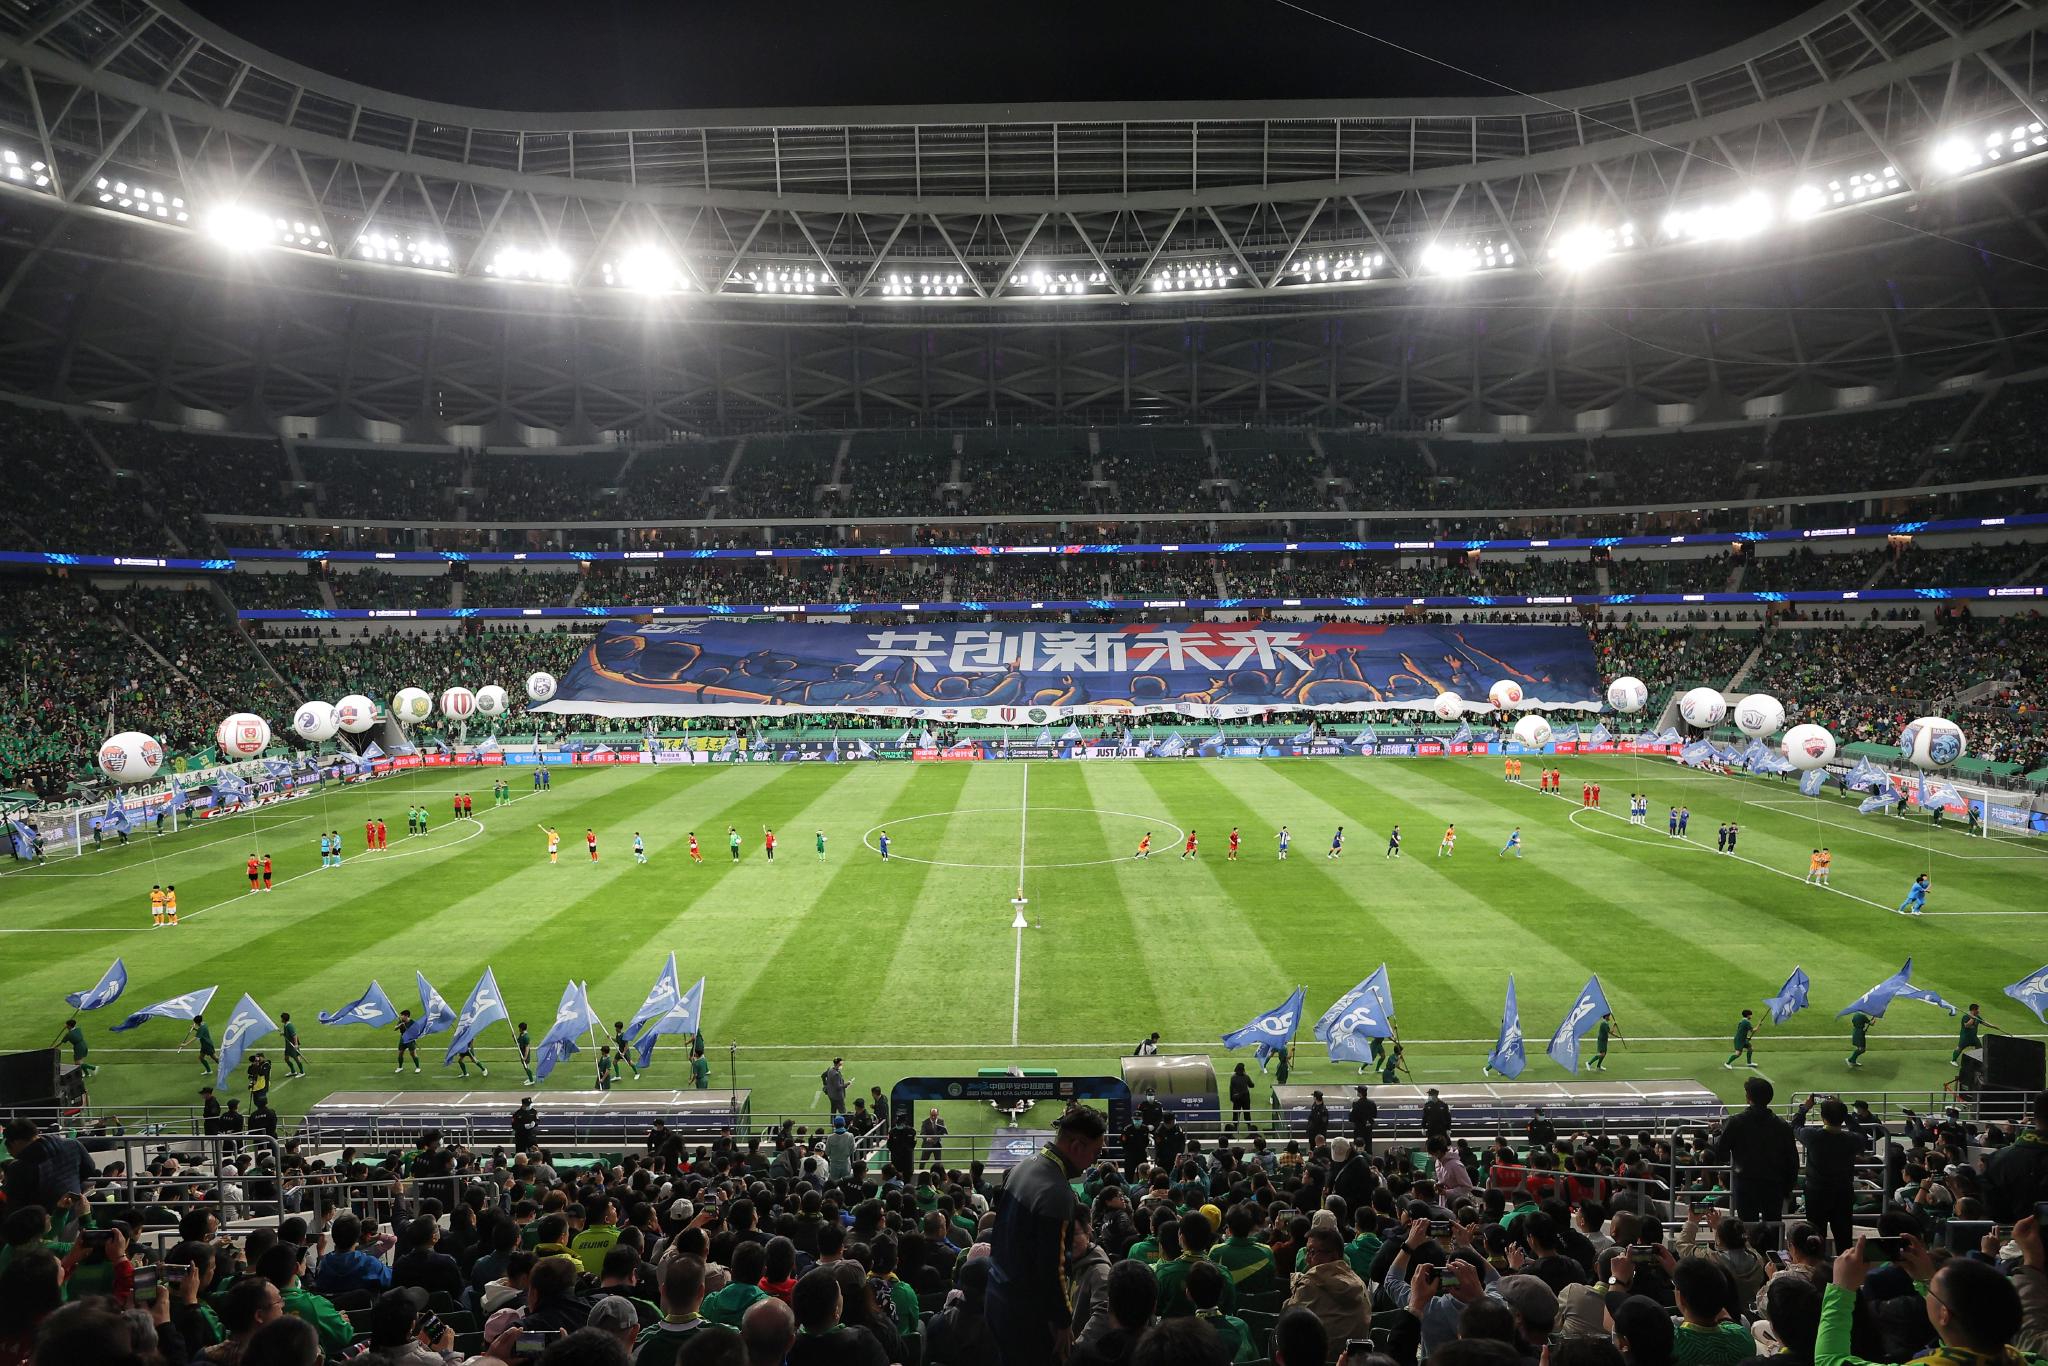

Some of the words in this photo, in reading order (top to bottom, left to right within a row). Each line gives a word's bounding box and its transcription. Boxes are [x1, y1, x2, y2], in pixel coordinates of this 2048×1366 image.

[855, 630, 1312, 672] 共创新未来
[1096, 749, 1114, 757] JUST
[1129, 749, 1138, 757] IT.
[989, 1082, 1054, 1090] 中国平安中超联赛
[579, 1240, 609, 1250] BEIJING
